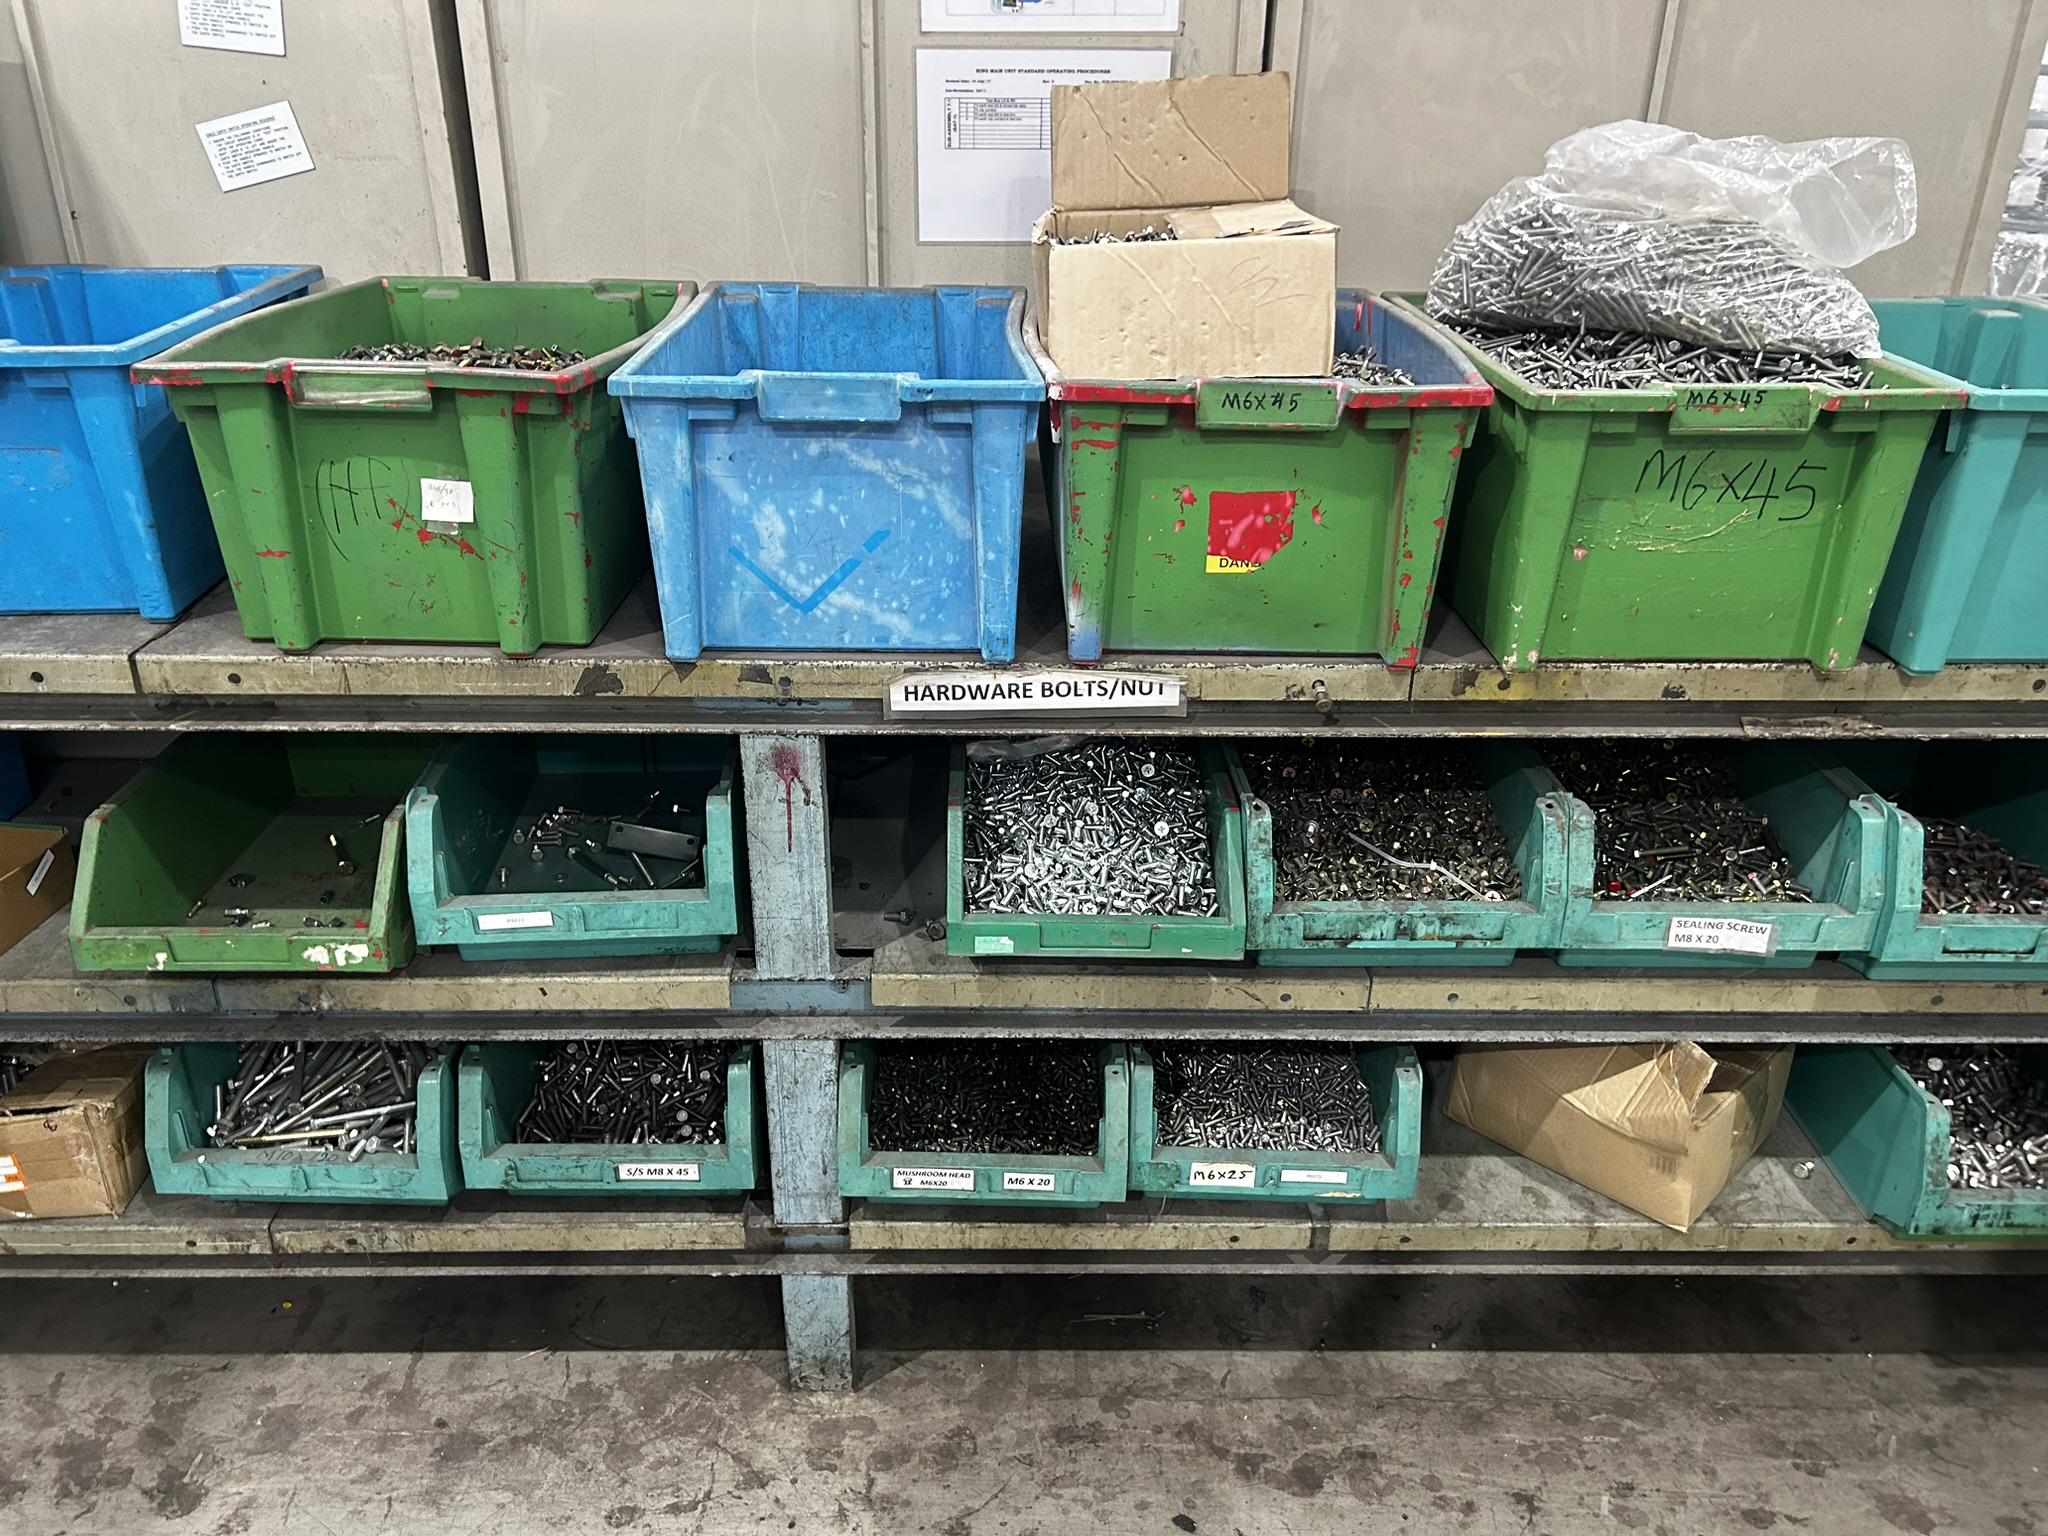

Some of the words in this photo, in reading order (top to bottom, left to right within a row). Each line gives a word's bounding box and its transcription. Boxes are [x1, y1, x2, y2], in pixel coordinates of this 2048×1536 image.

[904, 683, 1033, 702] HARDWARE
[1676, 920, 1724, 930] SEALING
[1726, 922, 1768, 935] SCREW
[1674, 933, 1692, 943] M8
[1705, 935, 1720, 944] 20
[626, 1167, 644, 1177] S/S
[646, 1168, 664, 1176] M8
[666, 1168, 673, 1176] X
[676, 1168, 689, 1176] 45
[896, 1170, 948, 1178] MUSHROOM
[919, 1179, 948, 1187] M6X20
[1007, 1177, 1026, 1186] M6
[1027, 1177, 1036, 1186] X
[1037, 1178, 1051, 1187] 20
